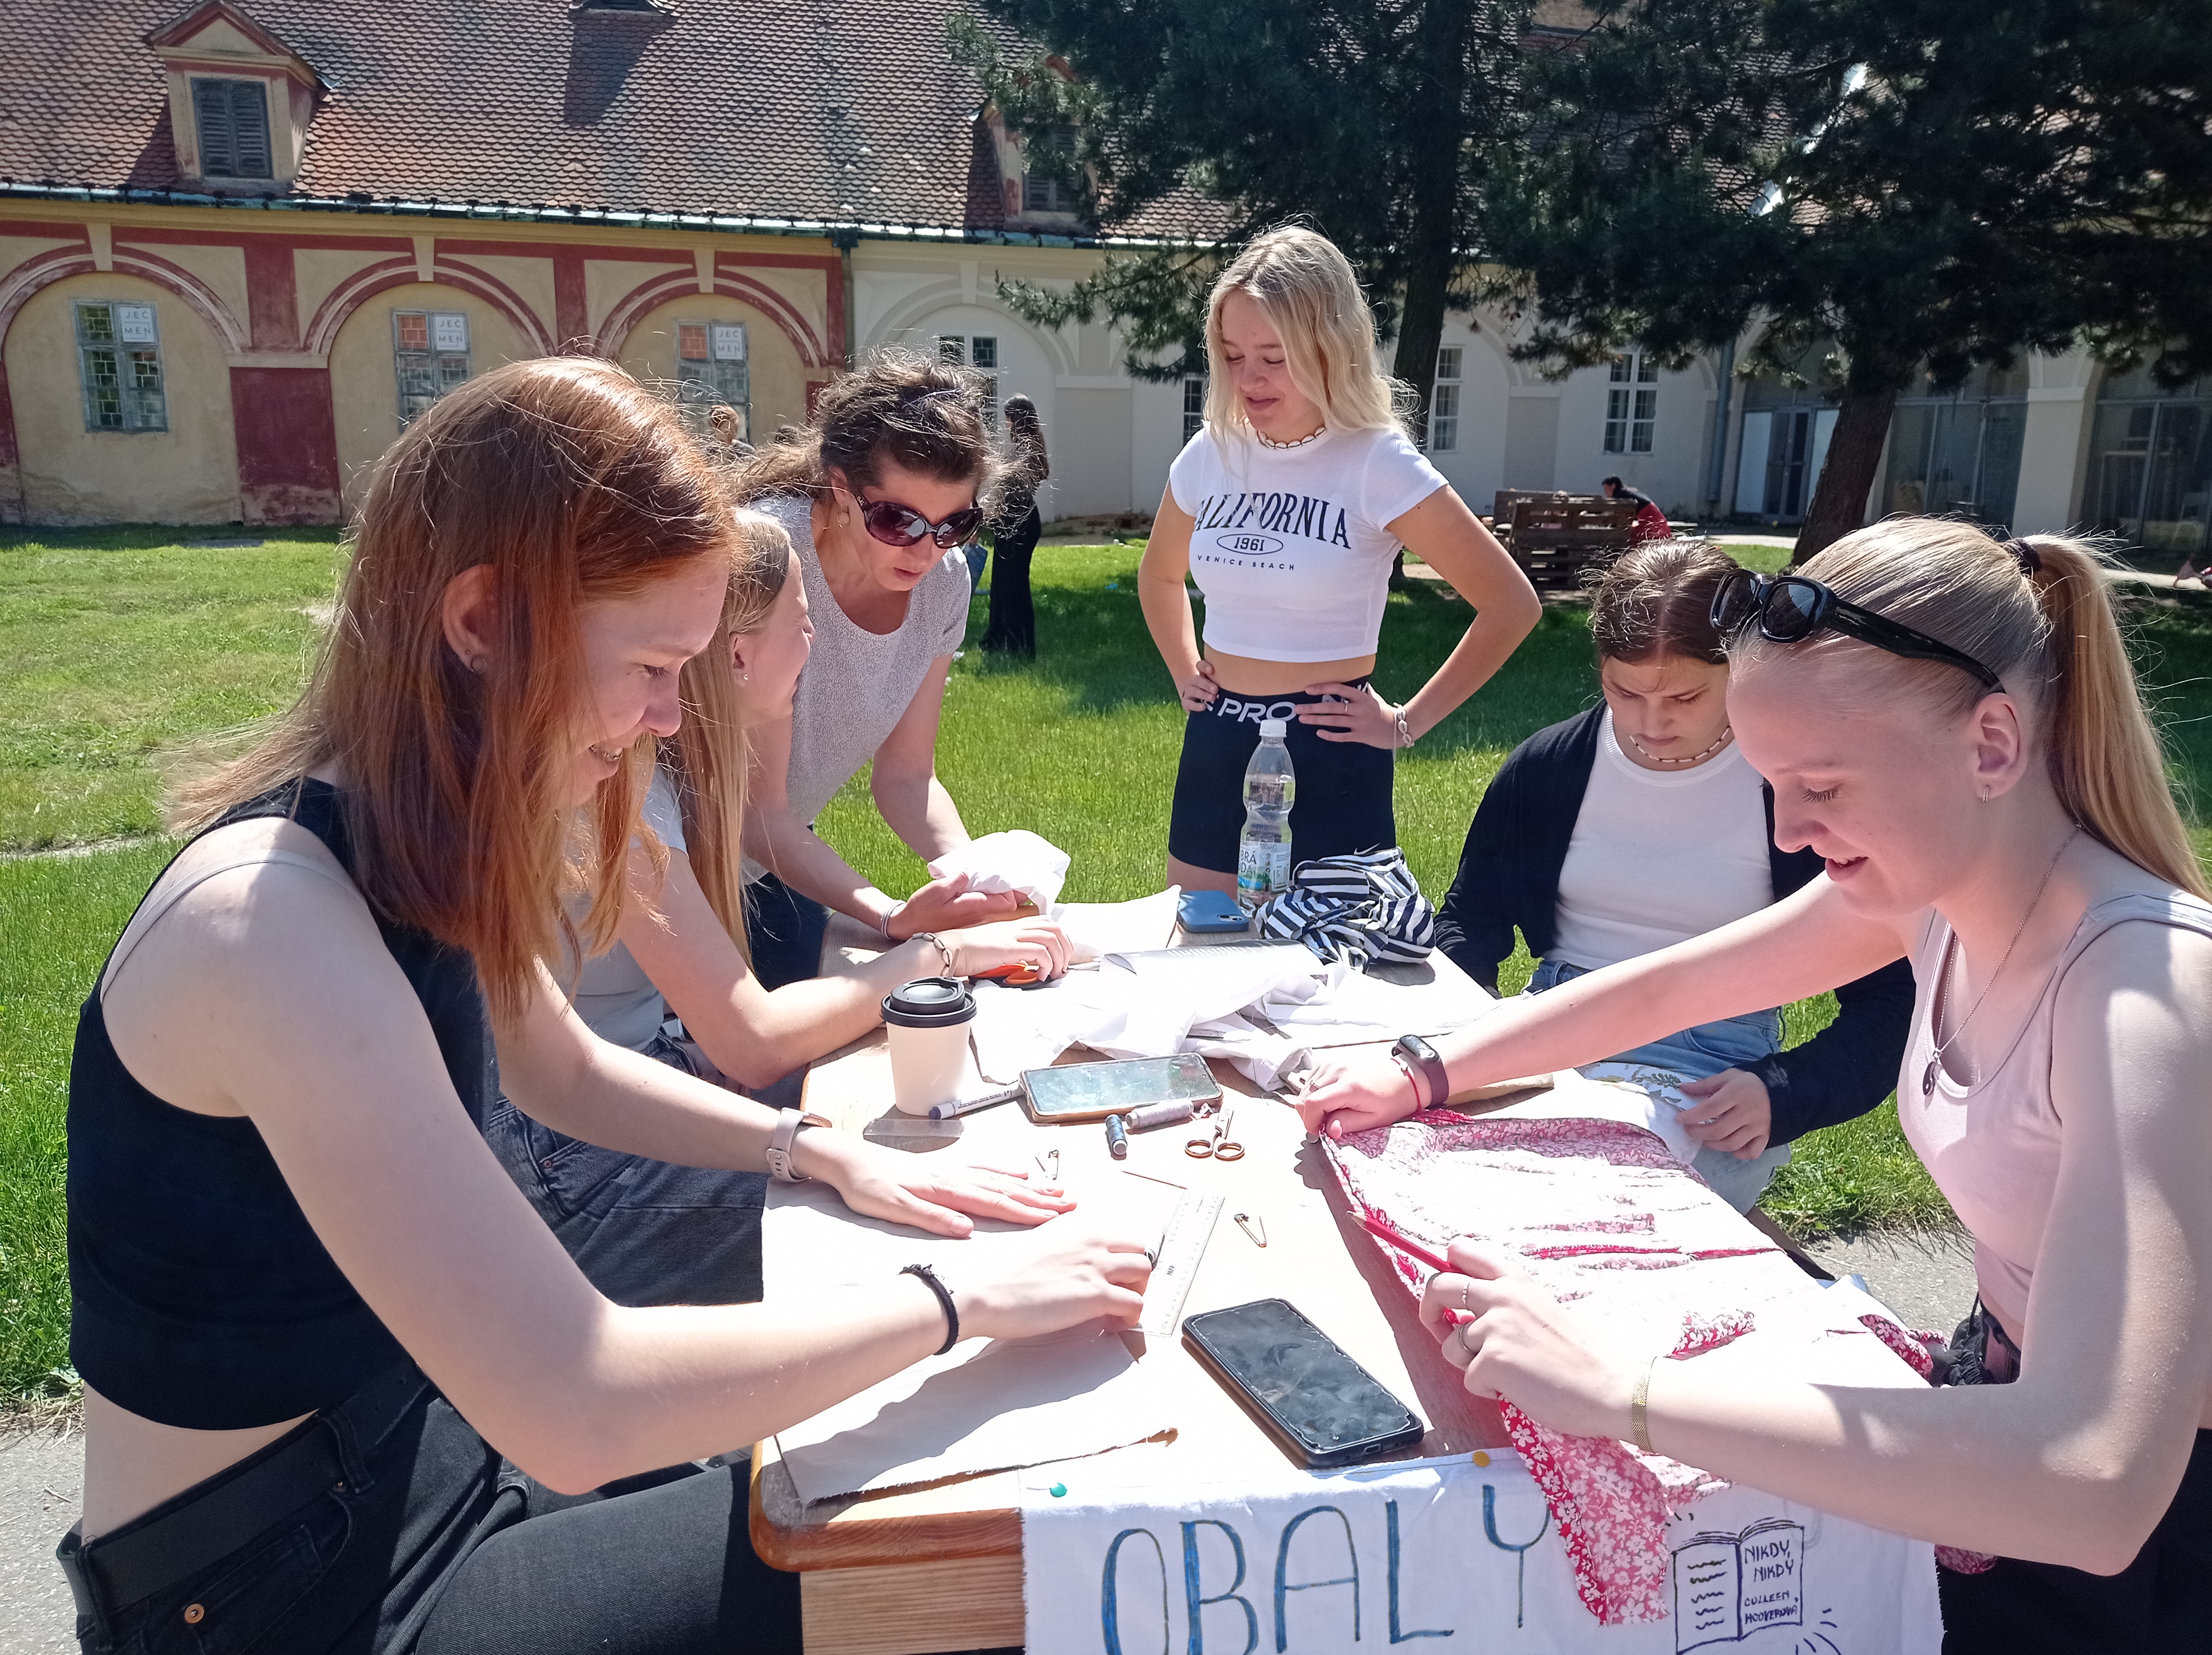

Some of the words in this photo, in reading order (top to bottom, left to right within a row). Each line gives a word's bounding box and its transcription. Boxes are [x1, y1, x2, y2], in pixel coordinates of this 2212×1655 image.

[439, 335, 463, 343] MEN
[1194, 492, 1352, 550] ALIFORNIA
[1233, 537, 1265, 552] 1961
[1197, 554, 1243, 566] VENICE
[1252, 561, 1295, 571] BEACH
[1217, 697, 1297, 724] PRO
[1240, 849, 1257, 865] BRÁ
[1745, 1539, 1790, 1564] NIKDY,
[1102, 1484, 1551, 1655] OBALY
[1754, 1558, 1794, 1583] NIKDY
